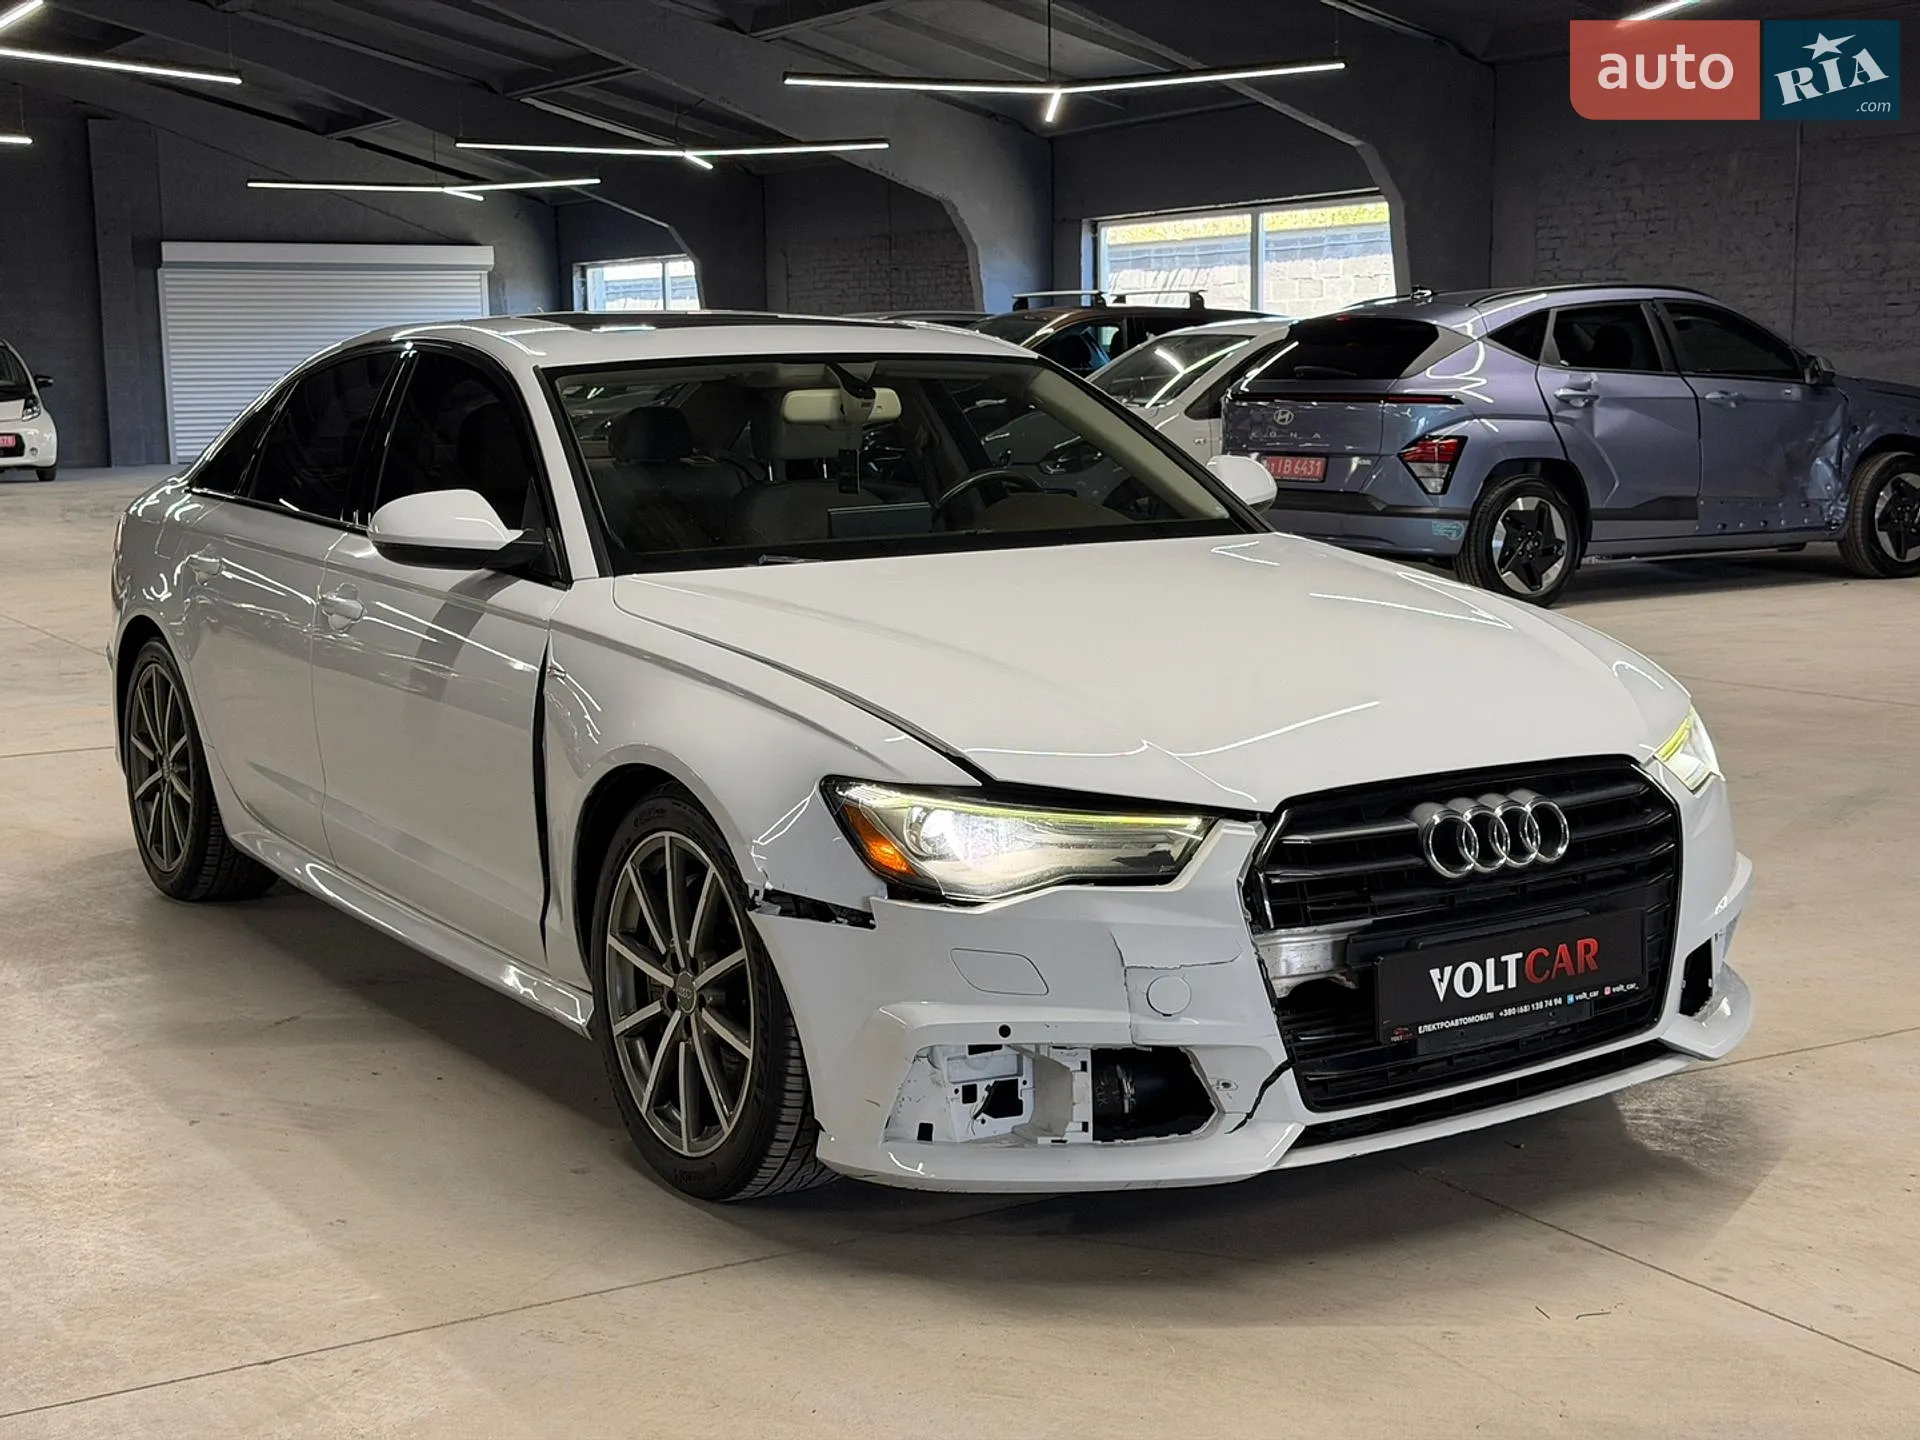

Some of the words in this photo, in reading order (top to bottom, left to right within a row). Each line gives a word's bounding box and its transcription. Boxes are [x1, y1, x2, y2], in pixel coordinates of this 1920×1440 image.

[1293, 459, 1321, 476] 6431
[1429, 937, 1599, 1003] VOLTCAR
[1575, 989, 1600, 1001] volt_car
[1418, 1013, 1494, 1034] ЕЛЕКТРОАВТОМОБІЛІ
[1499, 1006, 1516, 1017] +380
